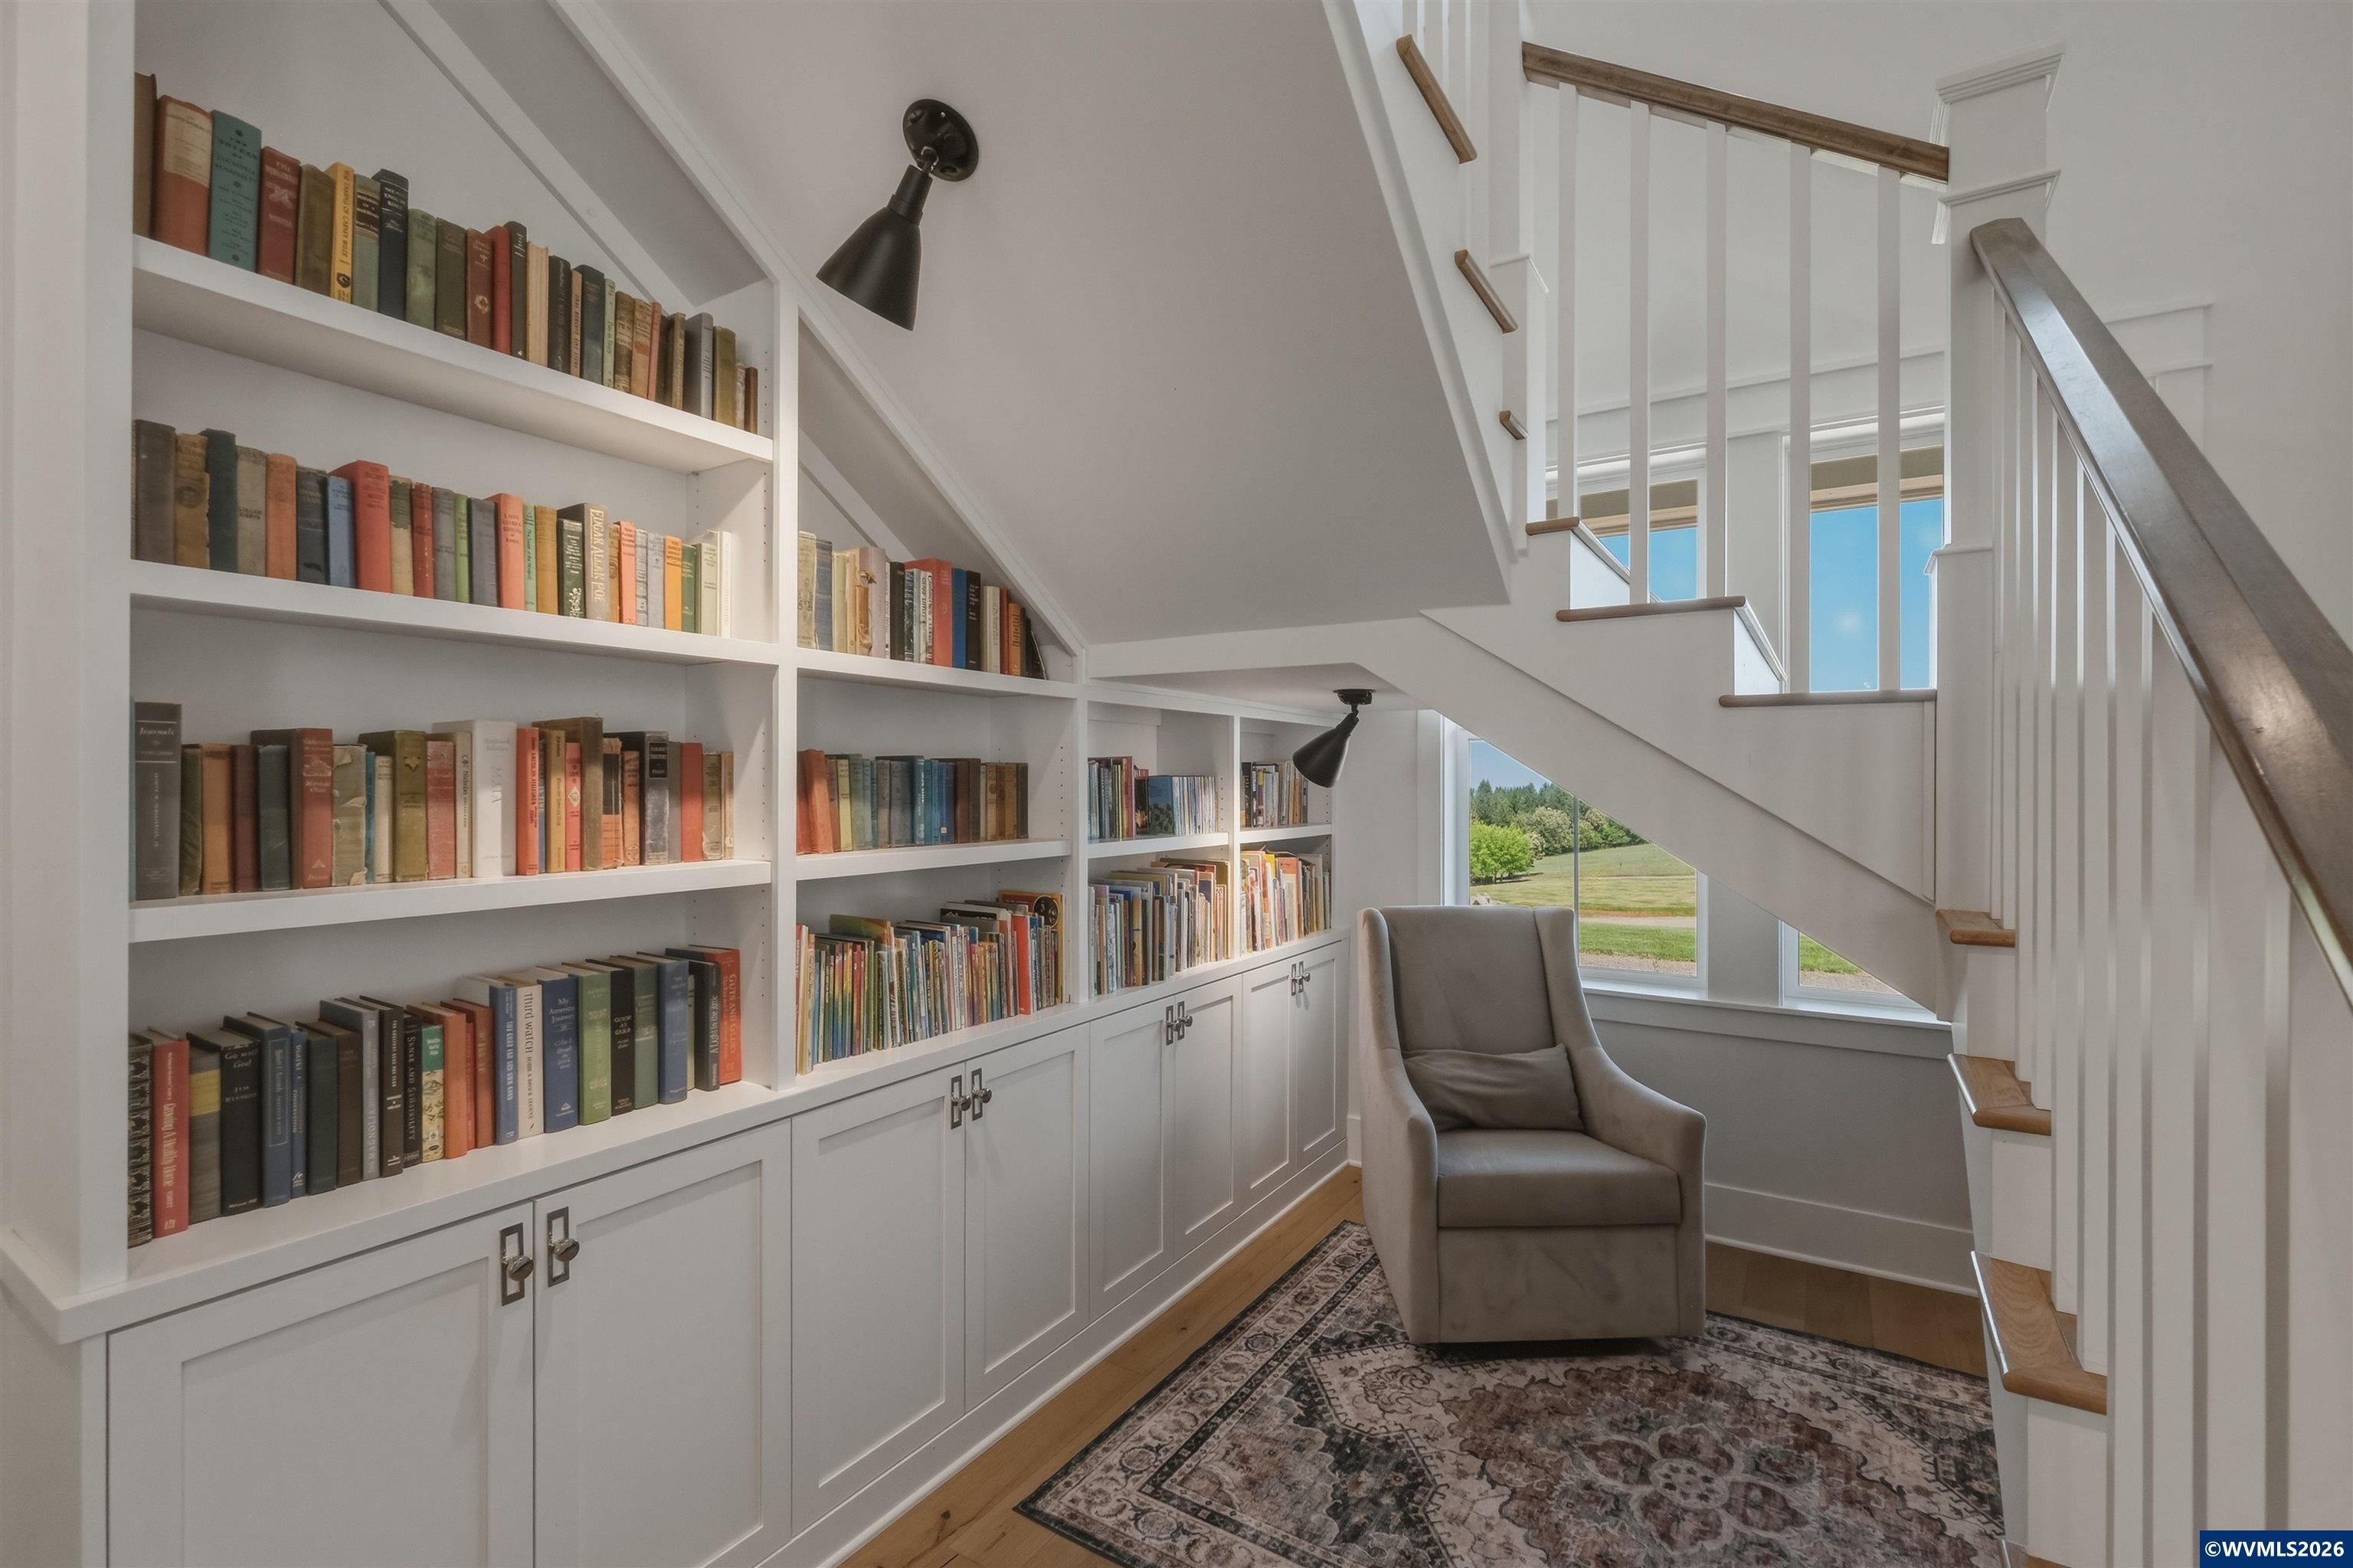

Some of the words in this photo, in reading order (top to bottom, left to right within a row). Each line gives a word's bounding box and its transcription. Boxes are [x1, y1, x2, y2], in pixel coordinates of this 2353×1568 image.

[590, 509, 604, 545] EDGAR
[590, 544, 605, 581] ALLAN
[591, 581, 606, 602] POE
[728, 973, 737, 1001] GUTS
[407, 1036, 416, 1062] SENSE
[728, 1023, 737, 1055] GLORY
